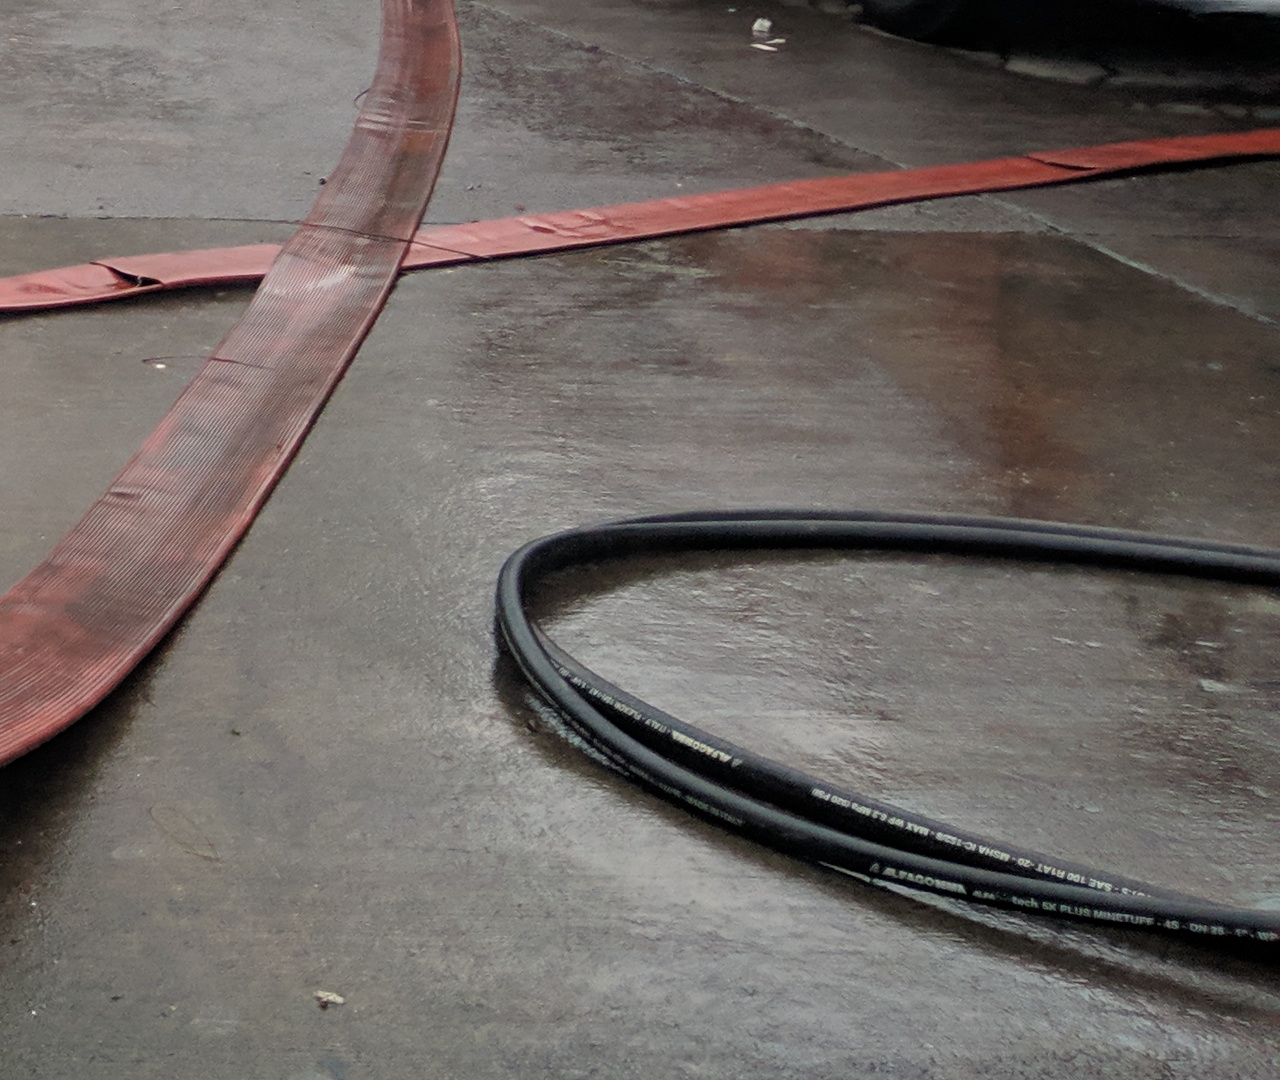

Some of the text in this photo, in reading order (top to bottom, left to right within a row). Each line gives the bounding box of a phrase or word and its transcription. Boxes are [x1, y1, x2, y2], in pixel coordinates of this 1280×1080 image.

[905, 822, 930, 837] MAX
[978, 845, 1011, 862] MSHA
[1036, 863, 1066, 878] R1AT
[1066, 873, 1085, 884] 100
[1089, 878, 1113, 892] SAE
[1060, 904, 1090, 918] PLUS
